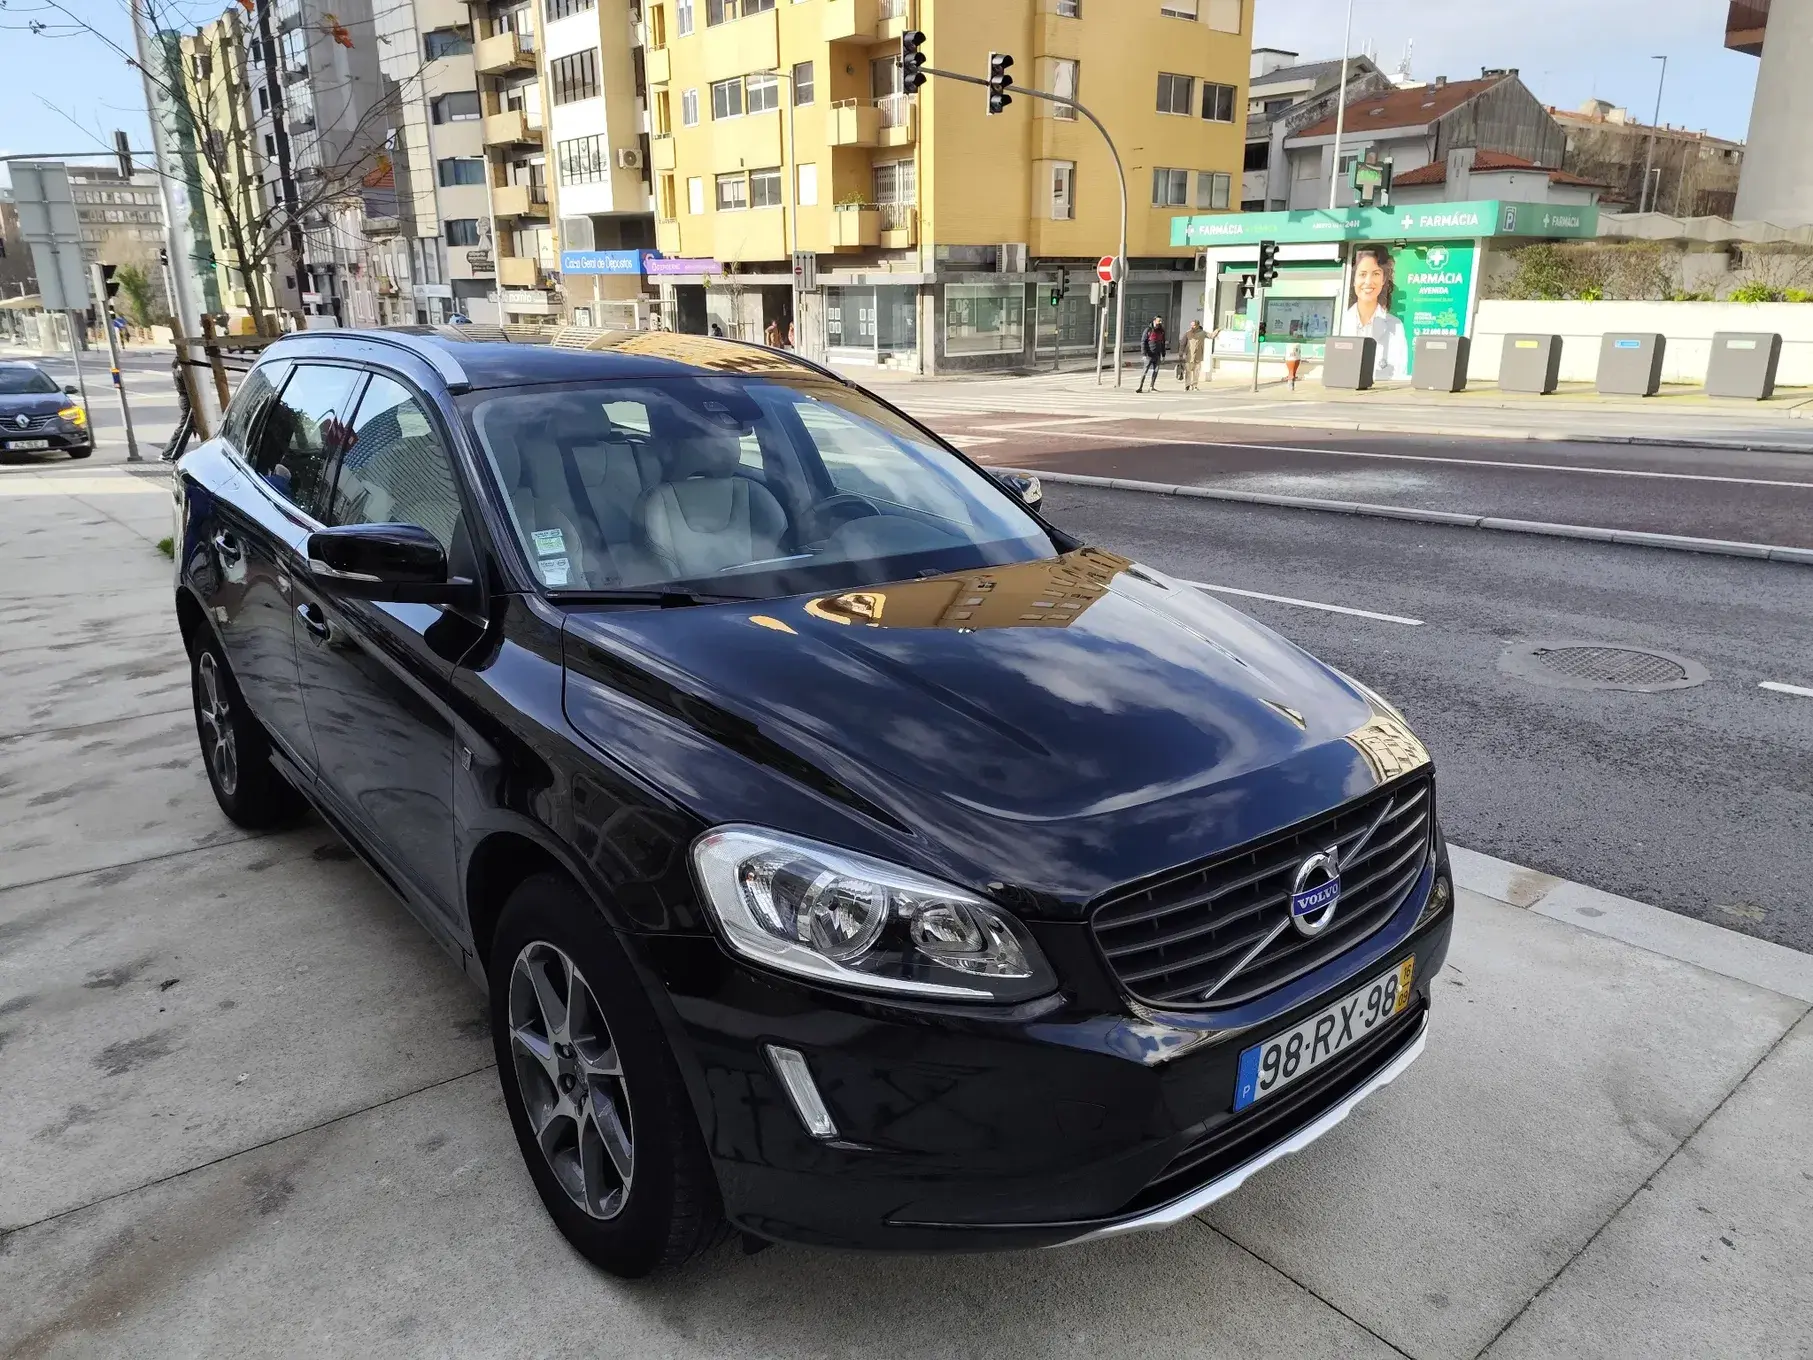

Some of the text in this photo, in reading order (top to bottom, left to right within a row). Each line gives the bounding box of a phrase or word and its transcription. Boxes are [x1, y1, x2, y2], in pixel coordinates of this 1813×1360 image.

[1344, 219, 1360, 229] 24H
[1419, 210, 1479, 228] FARMÁCIA
[1551, 213, 1580, 228] FARMÁCIA
[1199, 221, 1243, 235] FARMÁCIA
[597, 256, 605, 269] de
[1407, 271, 1463, 285] FARMÁCIA
[1418, 286, 1450, 295] AVENIDA
[1297, 882, 1339, 909] VOLVO
[1403, 963, 1412, 980] 16
[1242, 1084, 1251, 1099] P
